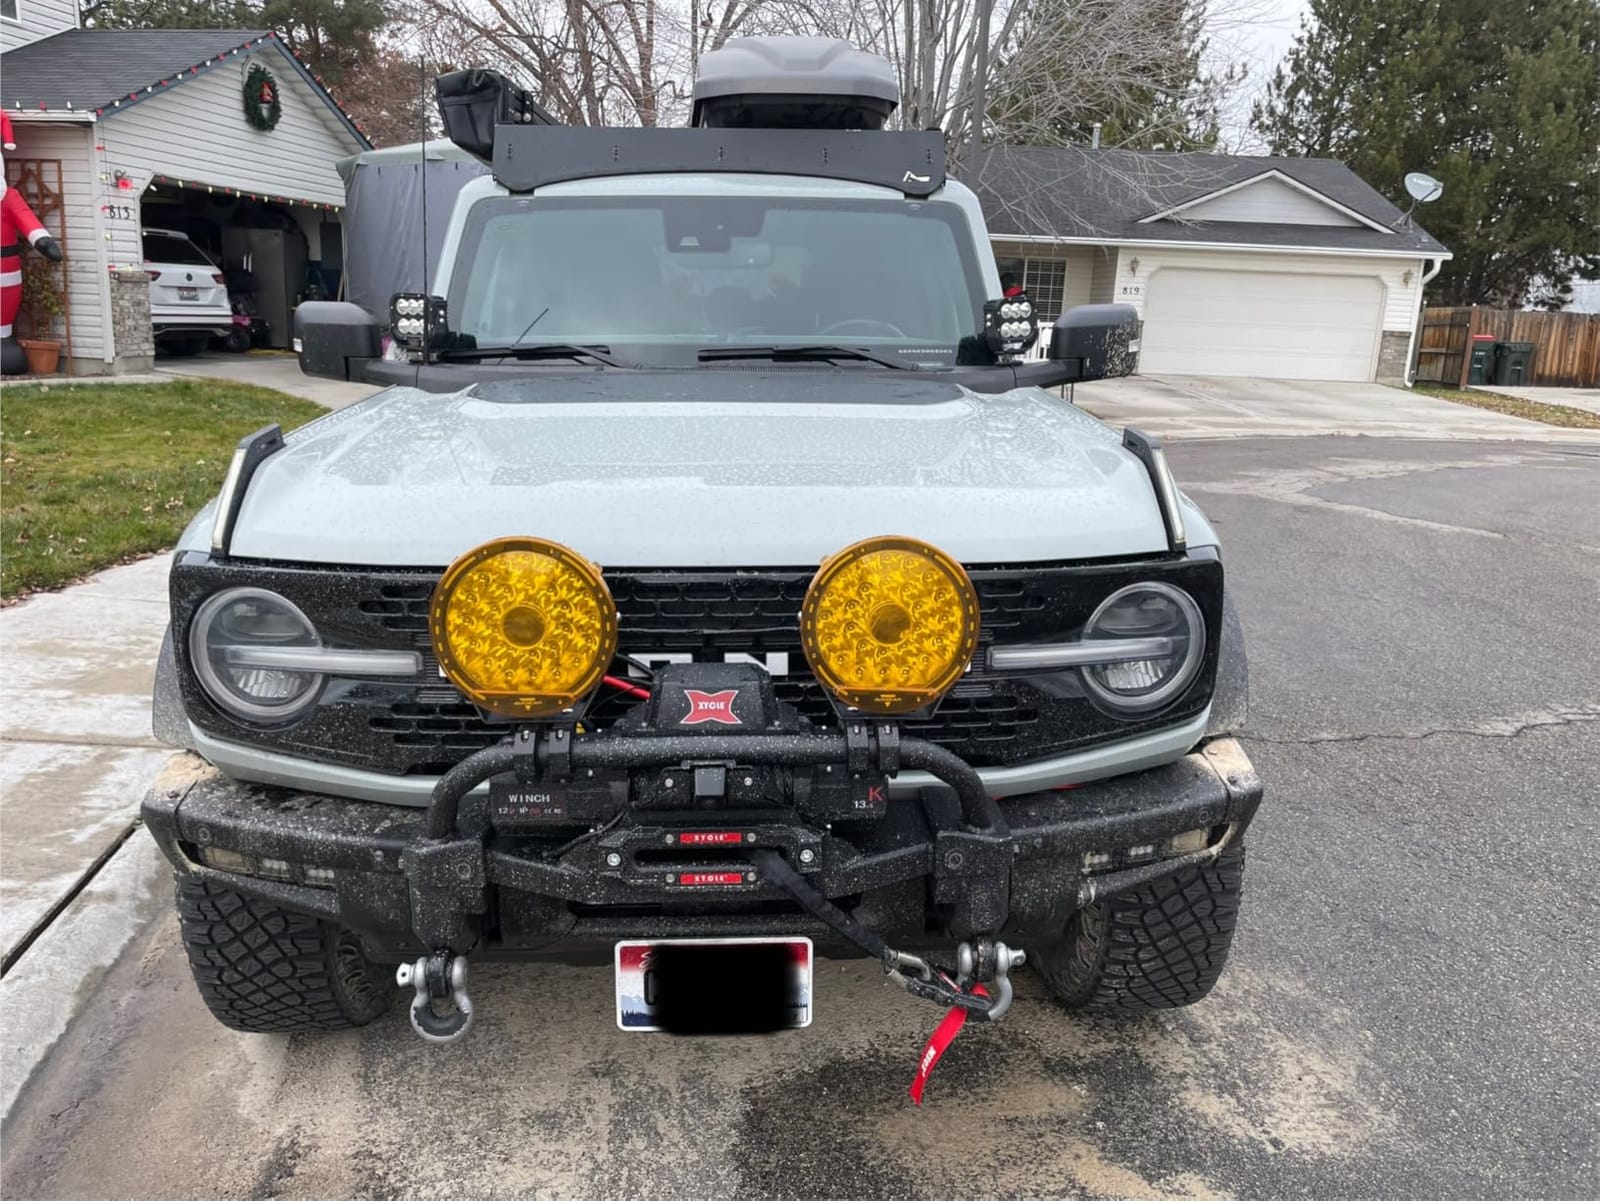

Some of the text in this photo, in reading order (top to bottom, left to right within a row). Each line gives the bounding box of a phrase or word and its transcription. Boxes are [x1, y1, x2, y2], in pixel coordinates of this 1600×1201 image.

[1121, 286, 1140, 296] 819
[508, 793, 551, 803] WINCH
[868, 786, 884, 801] K
